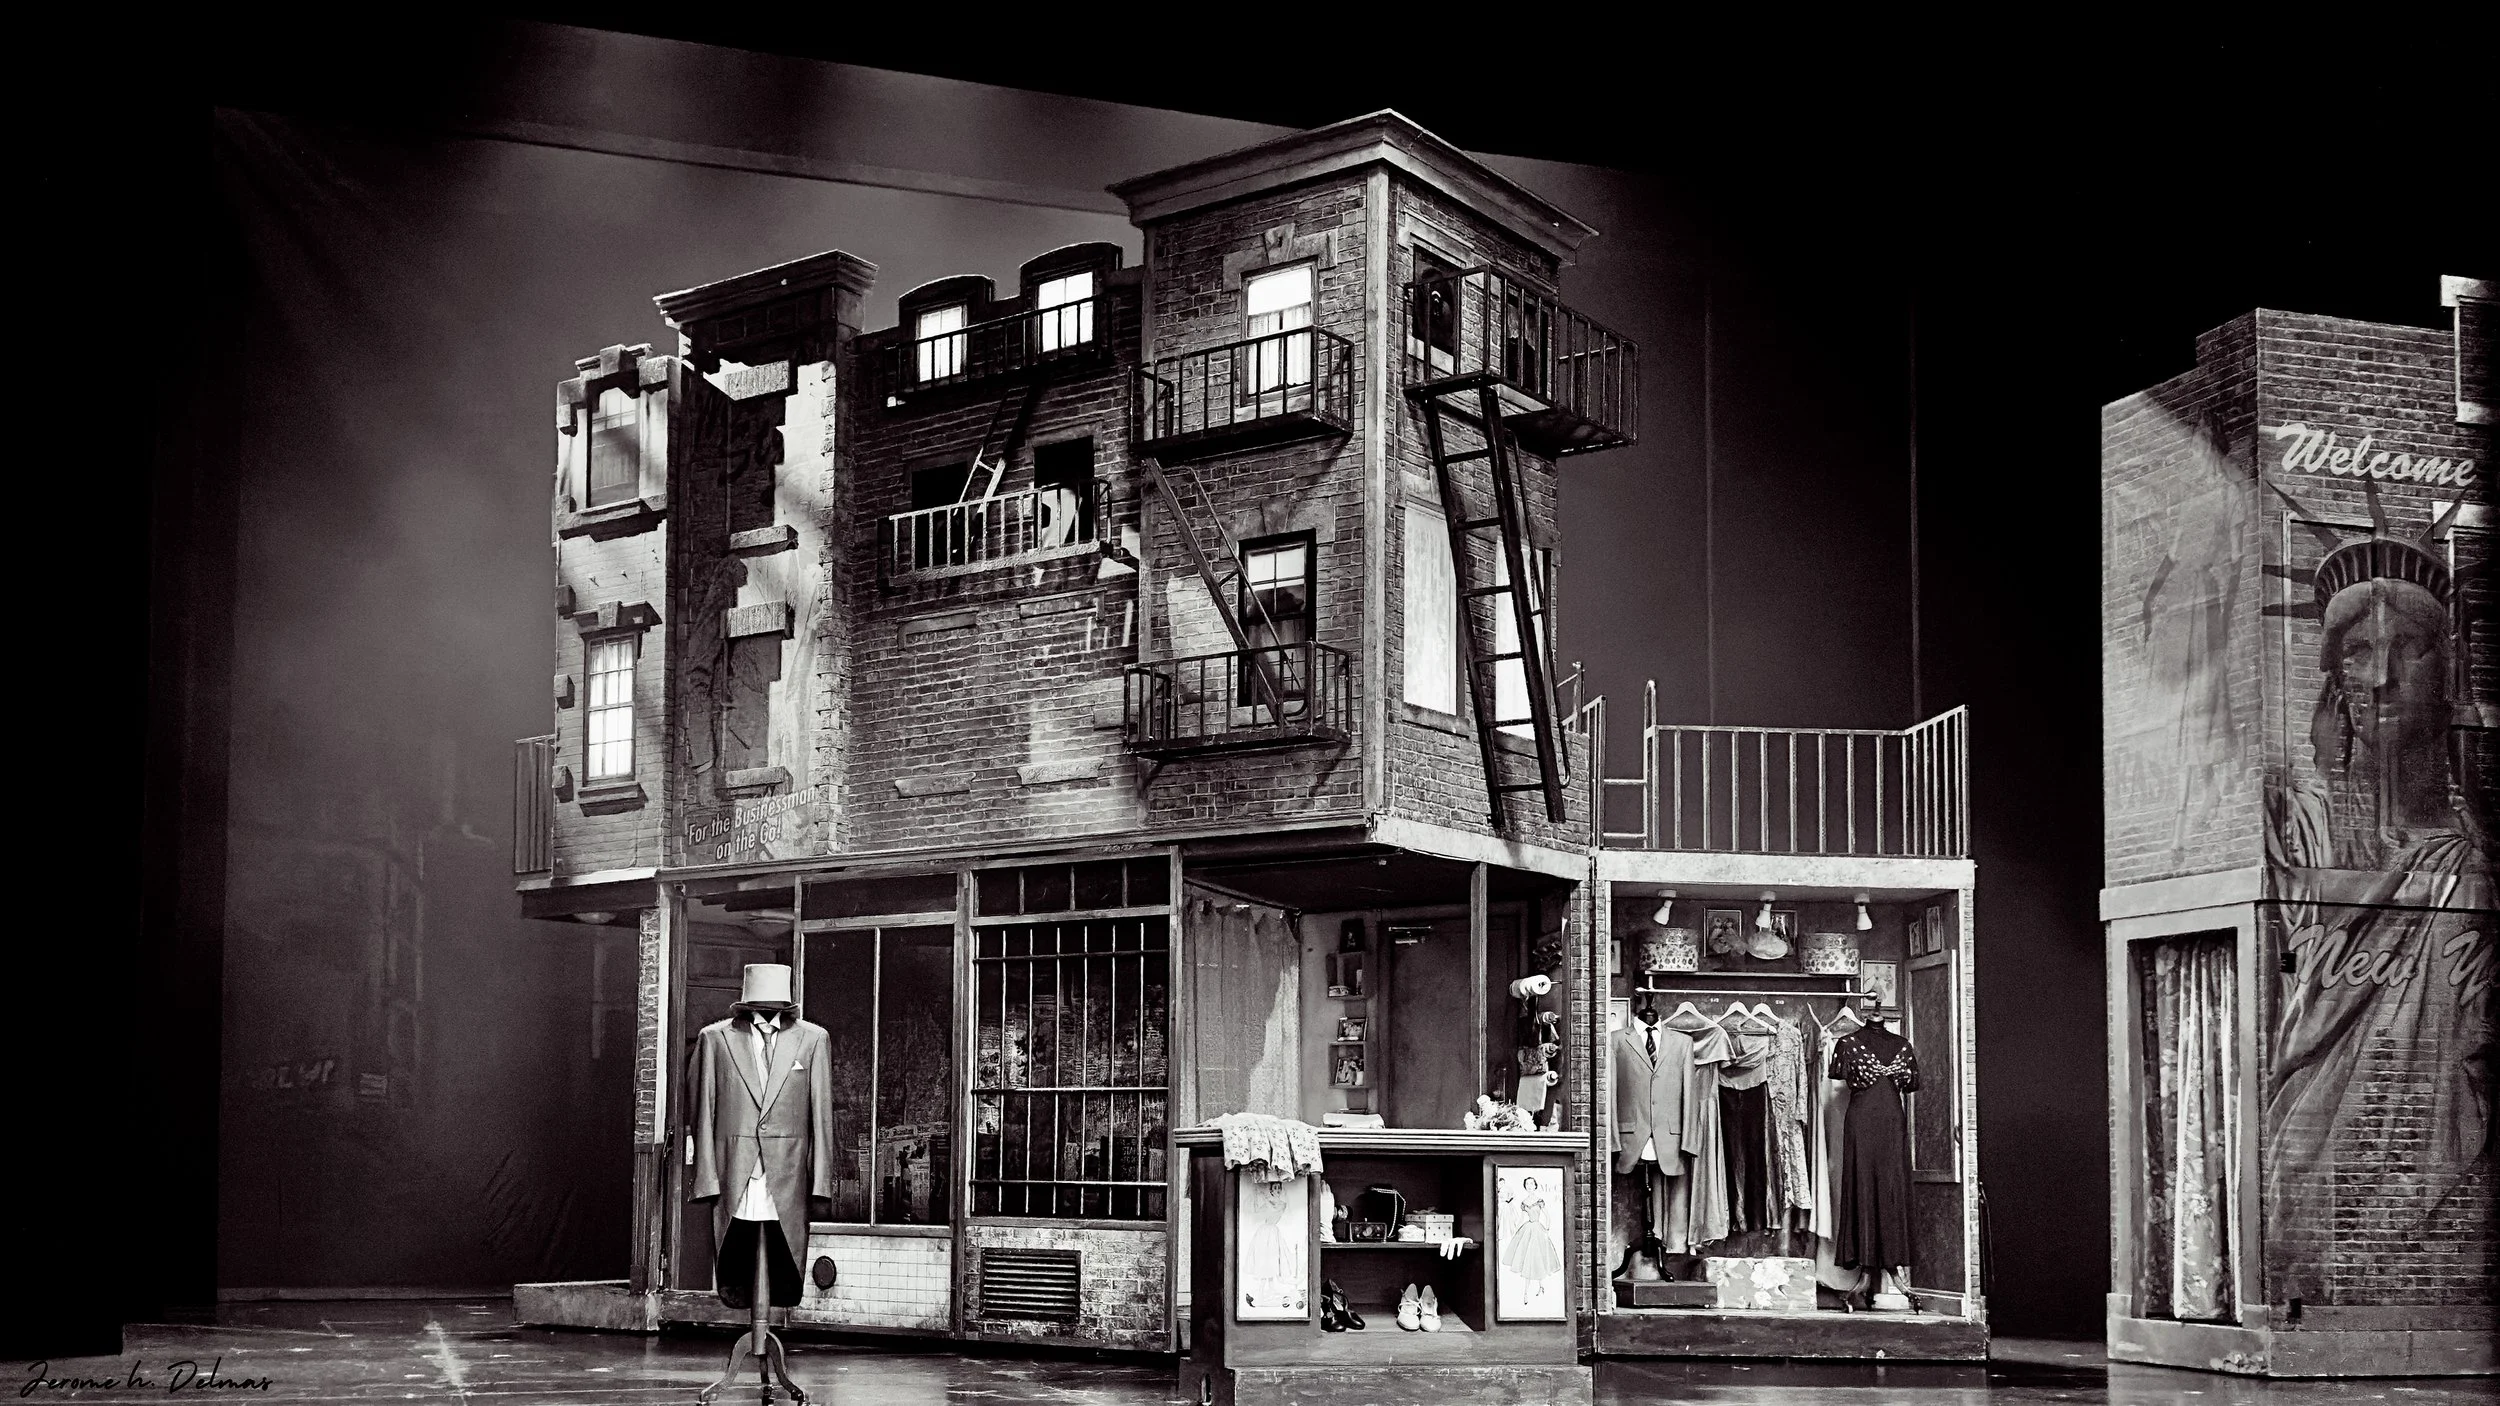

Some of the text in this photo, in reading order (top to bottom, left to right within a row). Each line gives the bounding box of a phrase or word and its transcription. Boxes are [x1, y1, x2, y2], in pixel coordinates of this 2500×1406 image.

[2276, 422, 2479, 487] Welcome
[688, 786, 815, 846] For the Businessman
[716, 817, 782, 860] on the Go!
[2289, 924, 2419, 990] New
